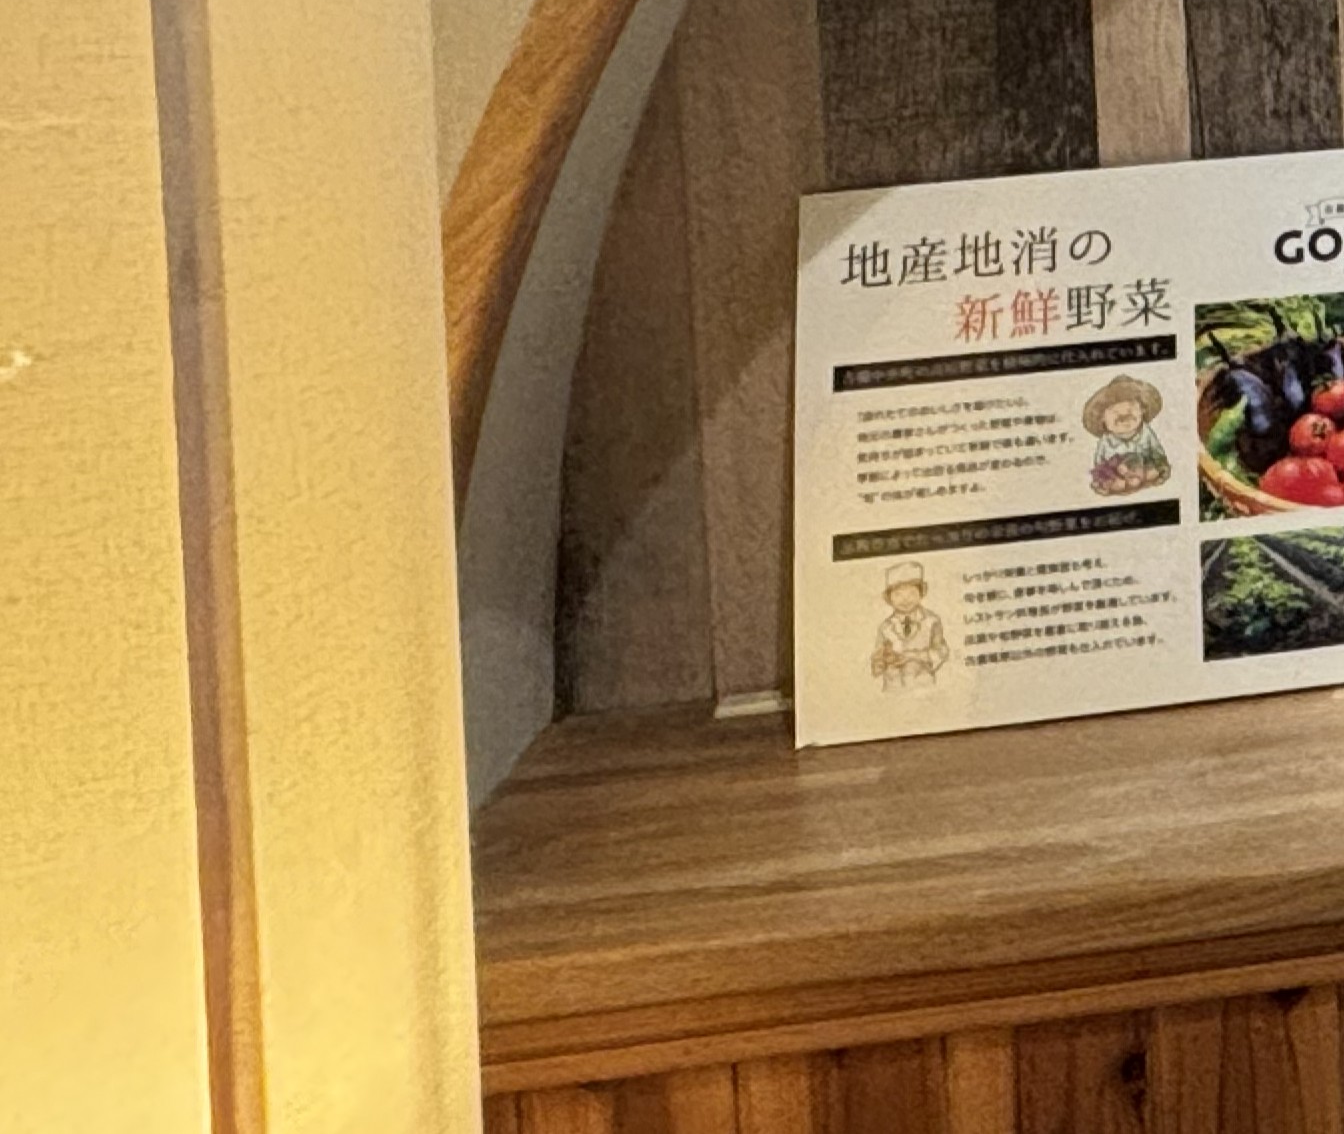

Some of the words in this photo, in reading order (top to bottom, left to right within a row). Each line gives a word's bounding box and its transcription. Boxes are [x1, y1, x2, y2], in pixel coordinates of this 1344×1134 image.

[839, 225, 1113, 288] 地産地消の
[953, 277, 1173, 344] 新鮮野菜
